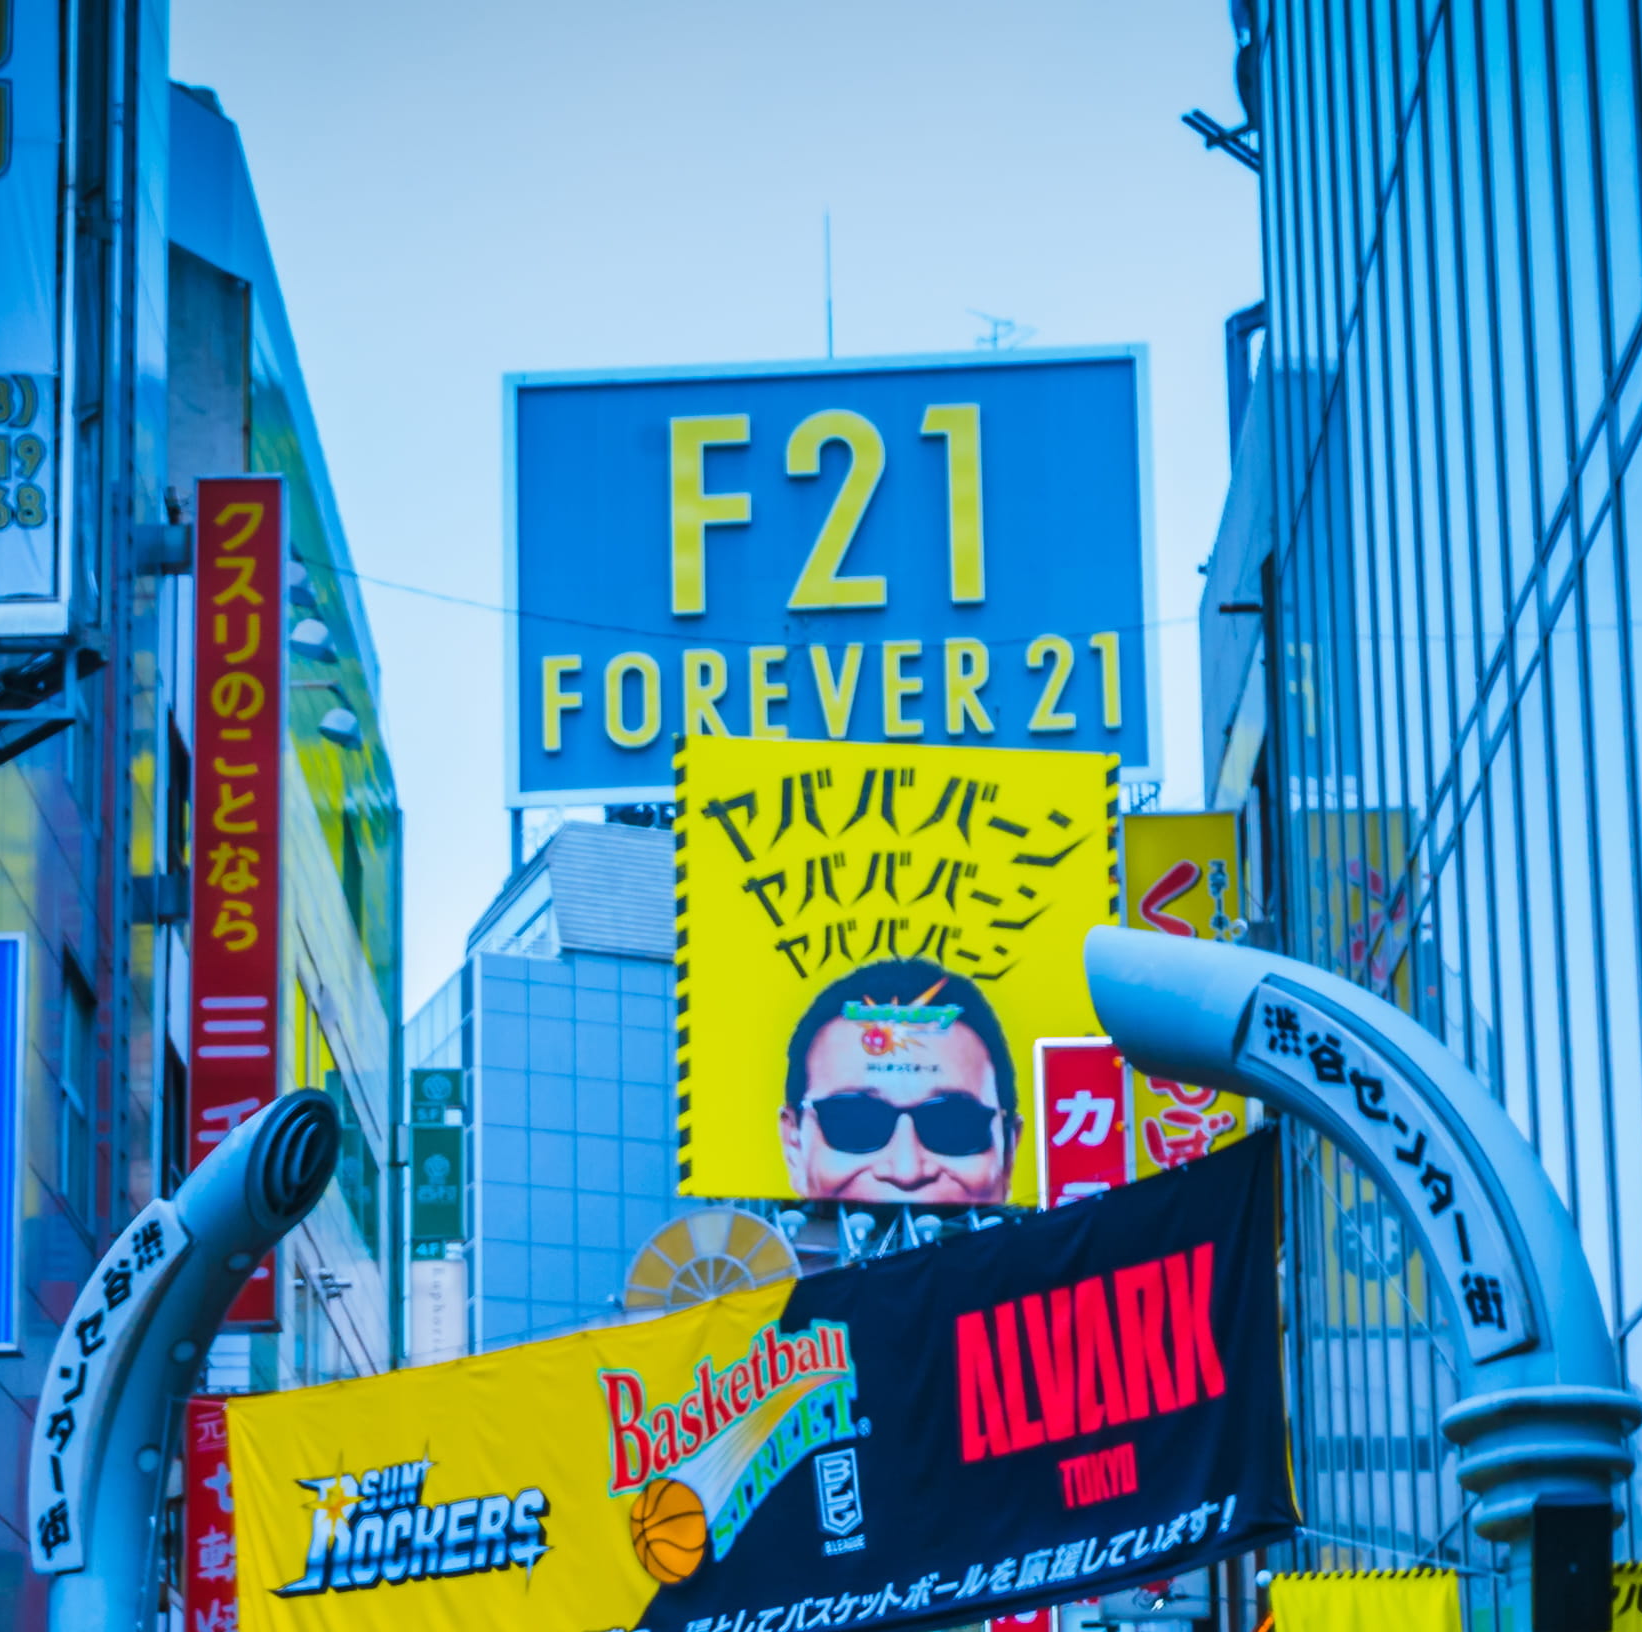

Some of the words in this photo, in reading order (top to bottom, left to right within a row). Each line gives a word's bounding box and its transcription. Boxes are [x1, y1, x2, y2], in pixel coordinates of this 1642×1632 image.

[669, 403, 985, 617] F21
[209, 502, 265, 952] クスリのことなら
[541, 636, 995, 753] FOREVER
[1026, 631, 1123, 732] 21
[701, 765, 1093, 865] ヤバババーン
[741, 851, 1053, 930] ヤバババーン
[775, 917, 1025, 982] ヤバババーン
[1264, 1004, 1509, 1333] 渋谷センター街
[37, 1219, 166, 1562] 渋谷センター街
[601, 1326, 850, 1492] Basketball
[955, 1242, 1226, 1463] ALVARK
[271, 1472, 551, 1598] ROCKERS
[361, 1464, 425, 1506] SUN
[713, 1381, 857, 1562] STREET
[1059, 1442, 1138, 1509] TOKYO
